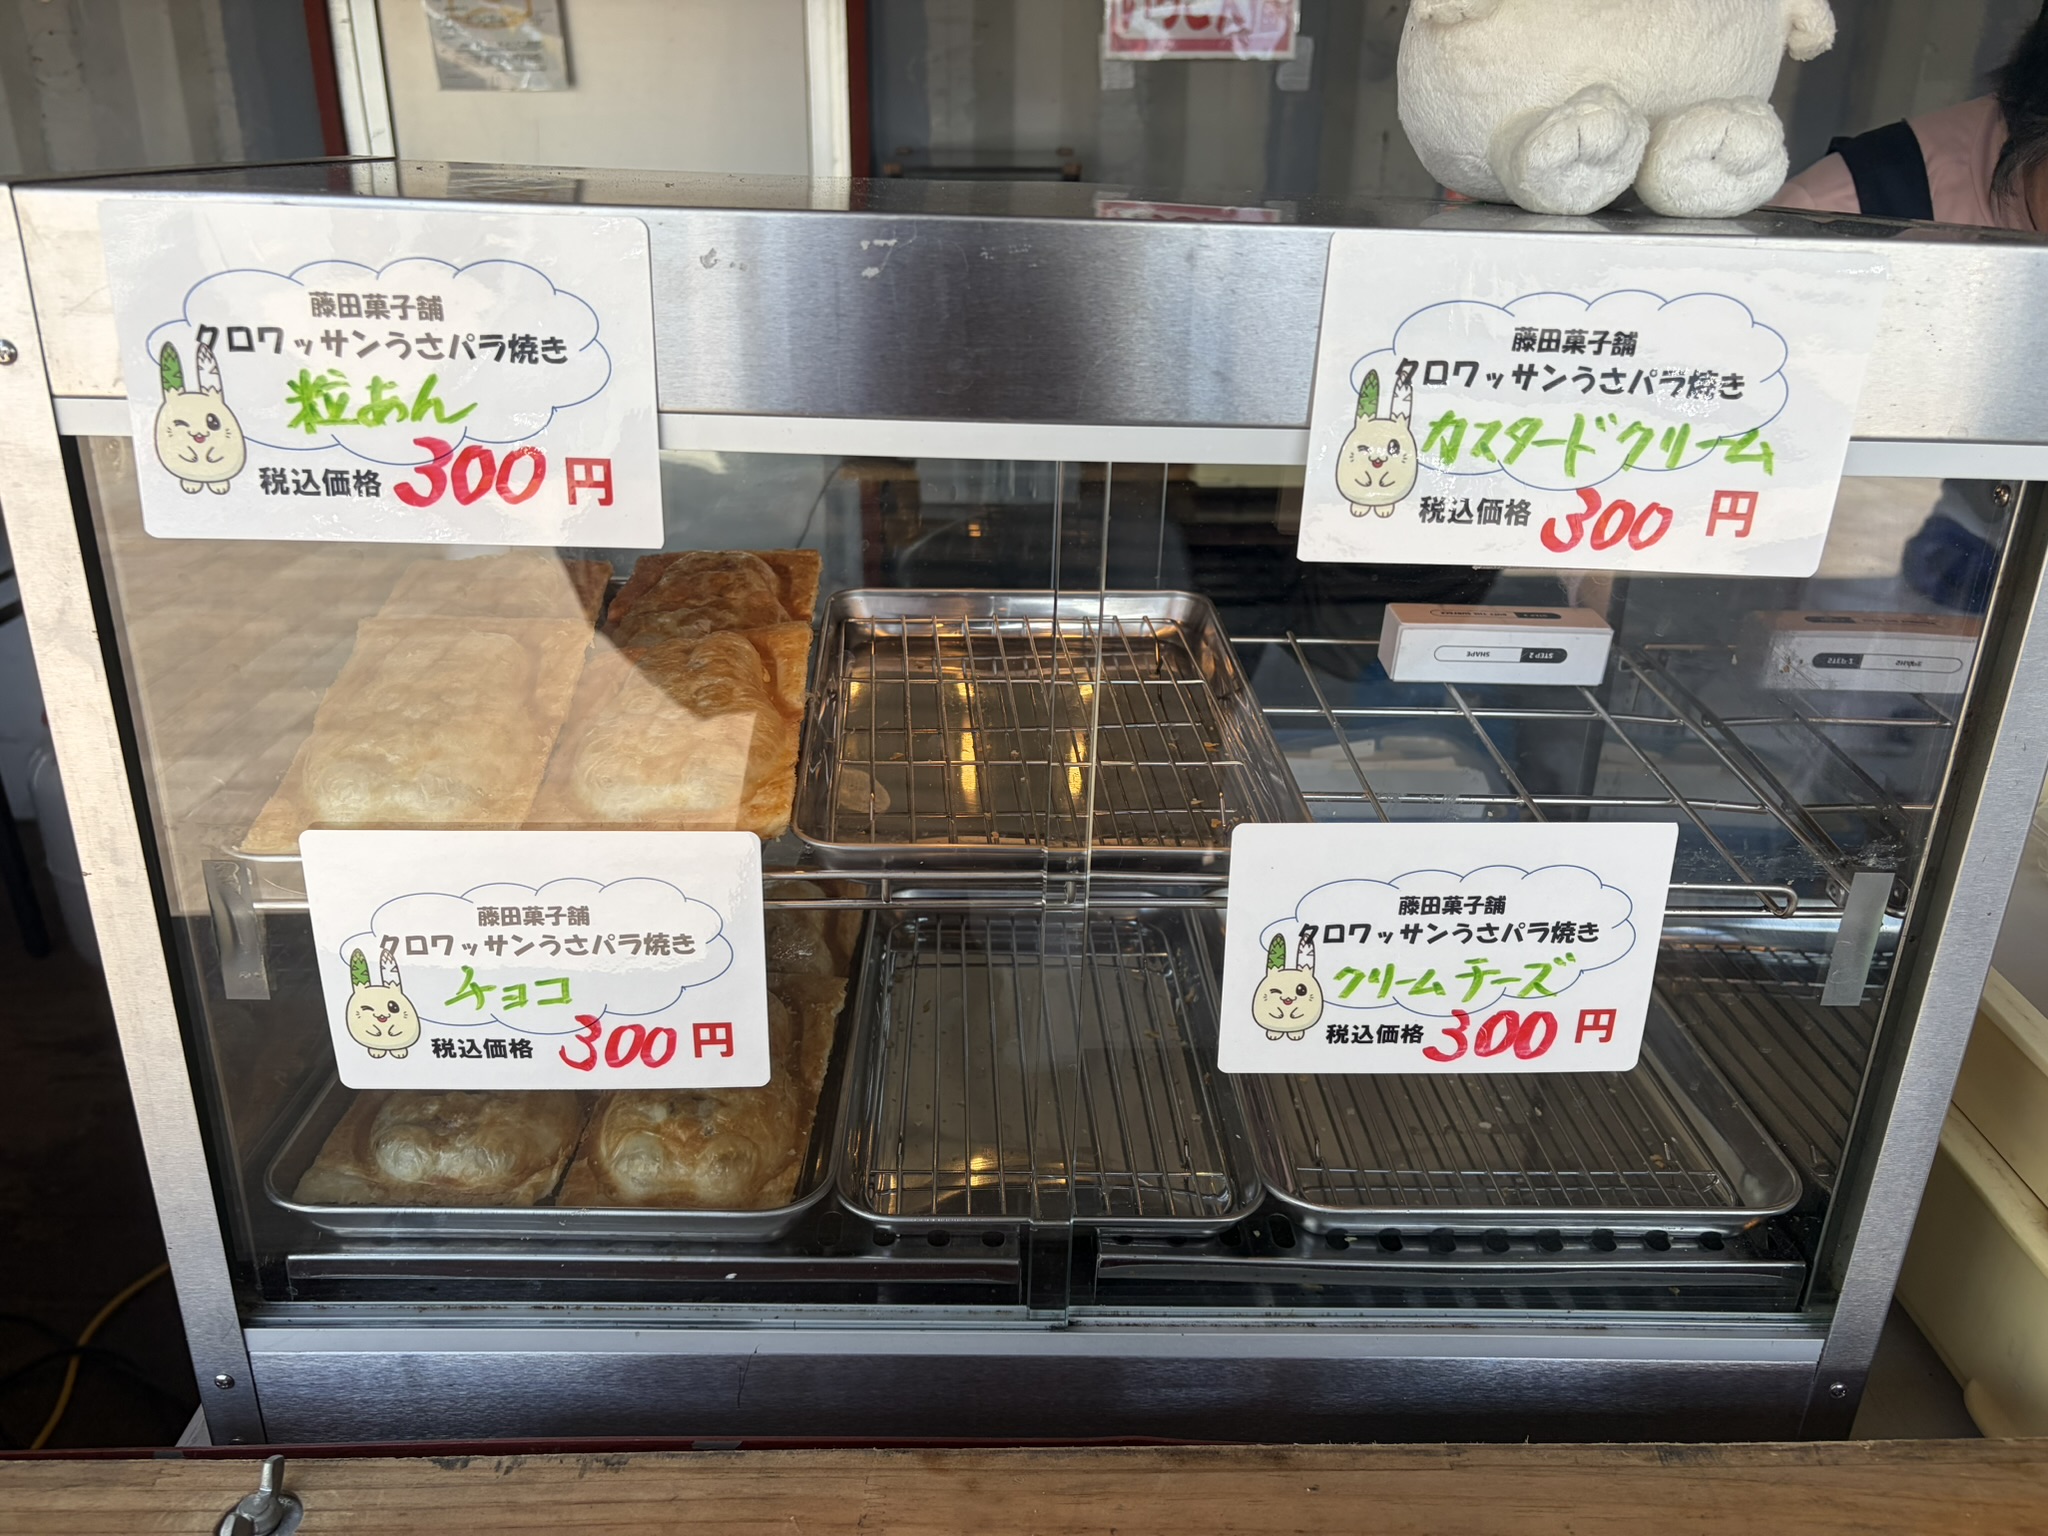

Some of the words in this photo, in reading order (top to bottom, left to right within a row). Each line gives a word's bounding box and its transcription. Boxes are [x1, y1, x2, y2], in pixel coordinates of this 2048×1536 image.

[310, 292, 443, 321] 藤田菓子舗
[1512, 326, 1638, 357] 藤田菓子舗
[286, 368, 477, 434] 粒あん
[1422, 409, 1776, 477] カスタードクリーム
[259, 466, 384, 498] 税込価格
[393, 436, 546, 507] 300
[565, 457, 614, 506] 円
[1418, 496, 1532, 527] 税込価格
[1540, 487, 1673, 553] 300
[1706, 490, 1758, 538] 円
[477, 905, 590, 927] 藤田菓子舗
[1398, 895, 1507, 916] 藤田菓子舗
[444, 965, 573, 1012] チョコ
[430, 1036, 533, 1059] 税込価格
[559, 1014, 678, 1071] 300
[692, 1022, 735, 1058] 円
[1325, 1023, 1425, 1045] 税込価格
[1422, 1009, 1559, 1063] 300
[1575, 1008, 1617, 1043] 円
